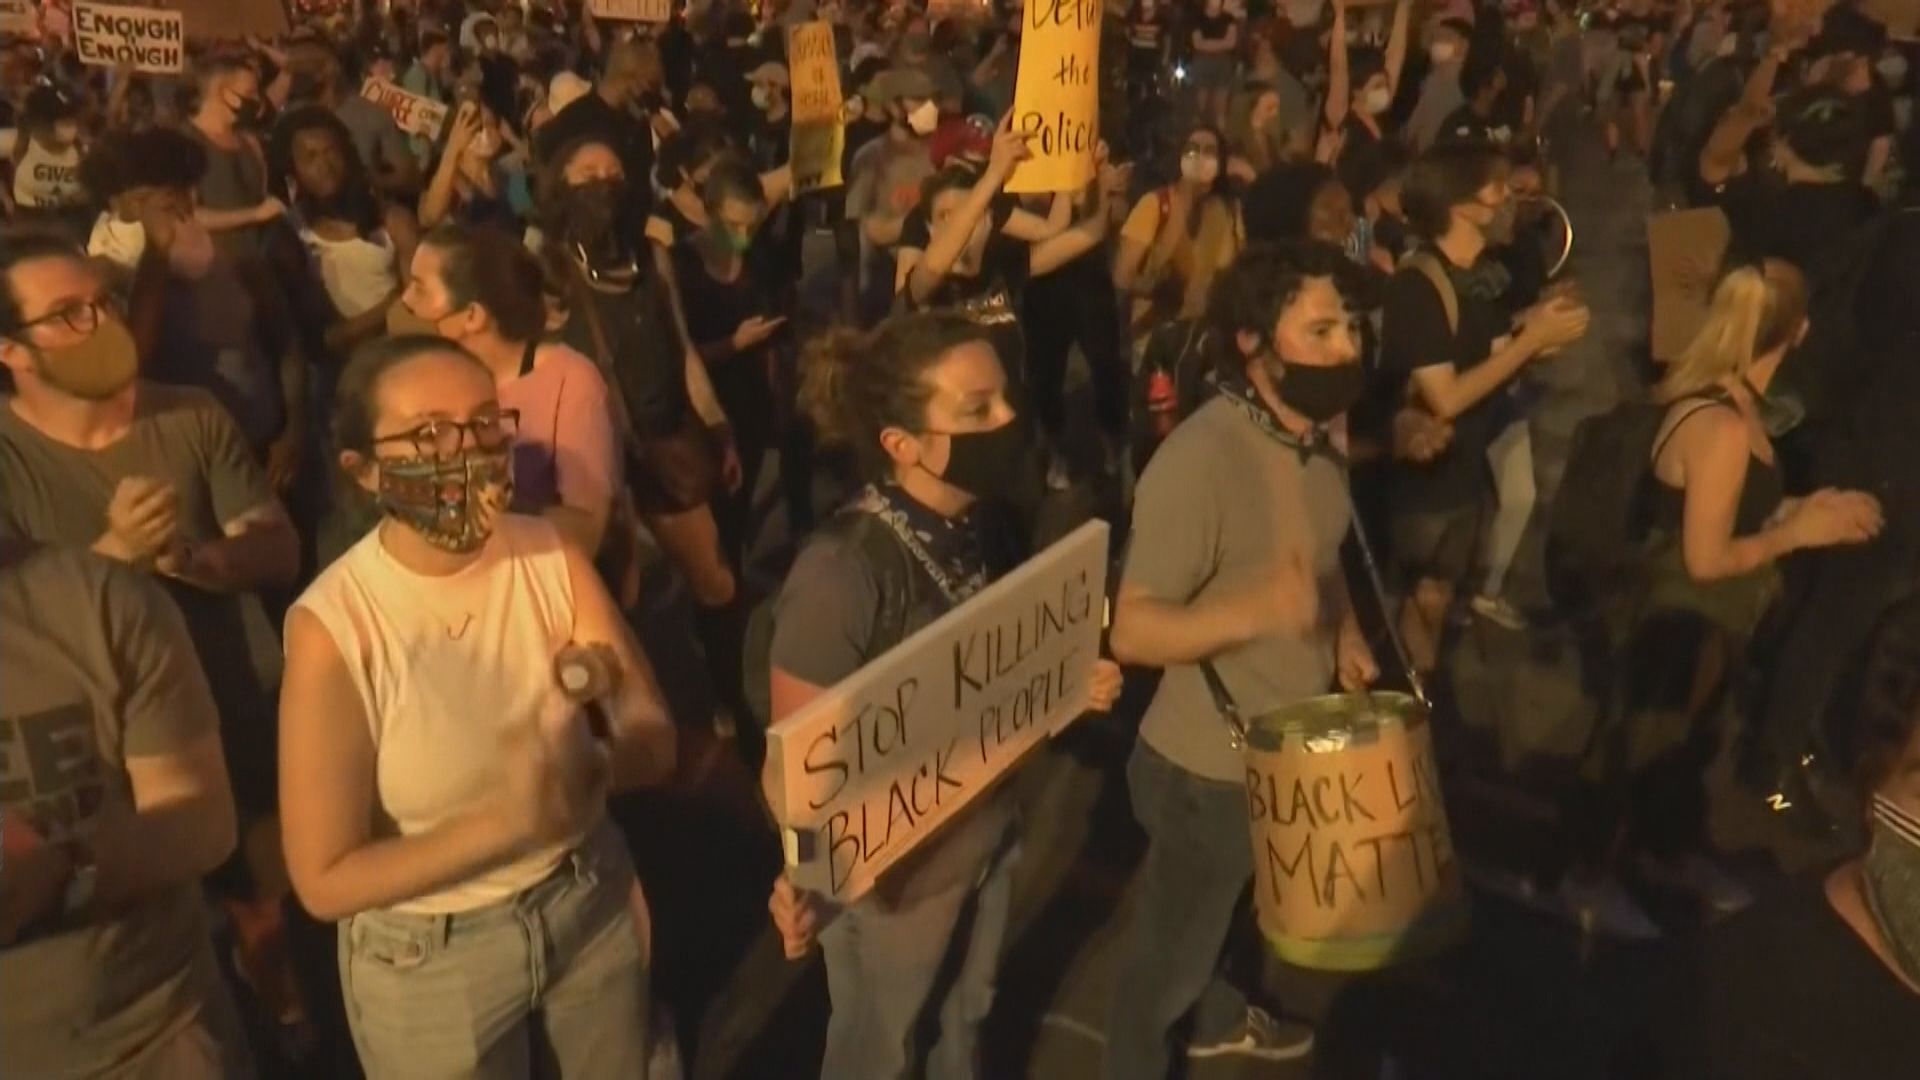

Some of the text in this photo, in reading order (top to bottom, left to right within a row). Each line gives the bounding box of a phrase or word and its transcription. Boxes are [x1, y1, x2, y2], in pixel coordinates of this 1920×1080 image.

[76, 7, 180, 41] ENOUGH
[80, 35, 179, 66] ENOUGH
[1053, 53, 1090, 86] the
[804, 571, 1091, 809] STOP KILLING
[823, 738, 963, 896] BLACK
[1246, 765, 1376, 831] BLACK
